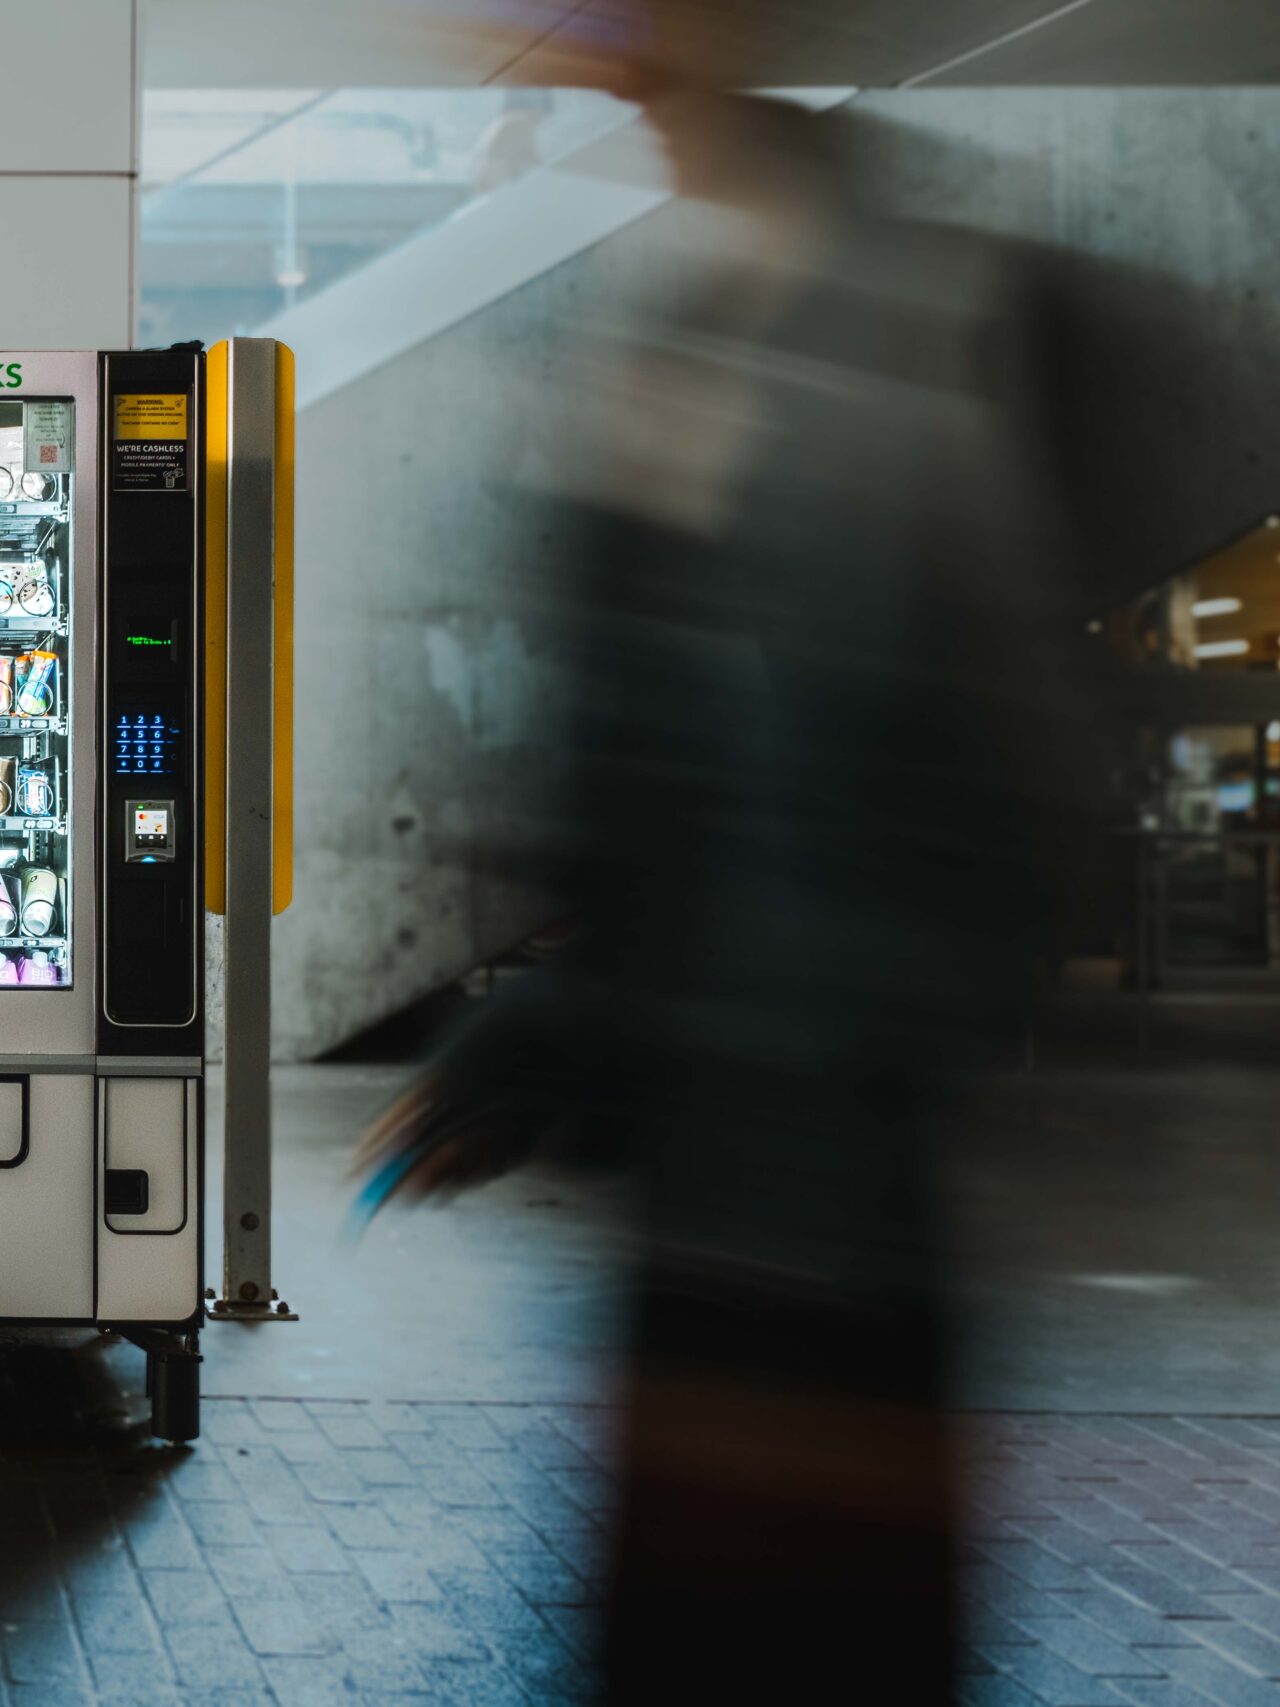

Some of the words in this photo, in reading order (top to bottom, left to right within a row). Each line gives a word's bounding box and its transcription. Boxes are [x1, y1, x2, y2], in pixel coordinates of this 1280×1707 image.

[142, 445, 184, 453] CASHLESS
[121, 715, 127, 724] 1
[137, 715, 144, 724] 2
[154, 715, 161, 724] 3
[20, 720, 31, 728] 39
[120, 730, 127, 738] 4
[137, 730, 144, 738] 5
[154, 730, 161, 738] 6
[121, 745, 127, 753] 7
[137, 745, 144, 753] 8
[154, 745, 161, 753] 9
[137, 760, 144, 768] 0
[25, 820, 35, 828] 49
